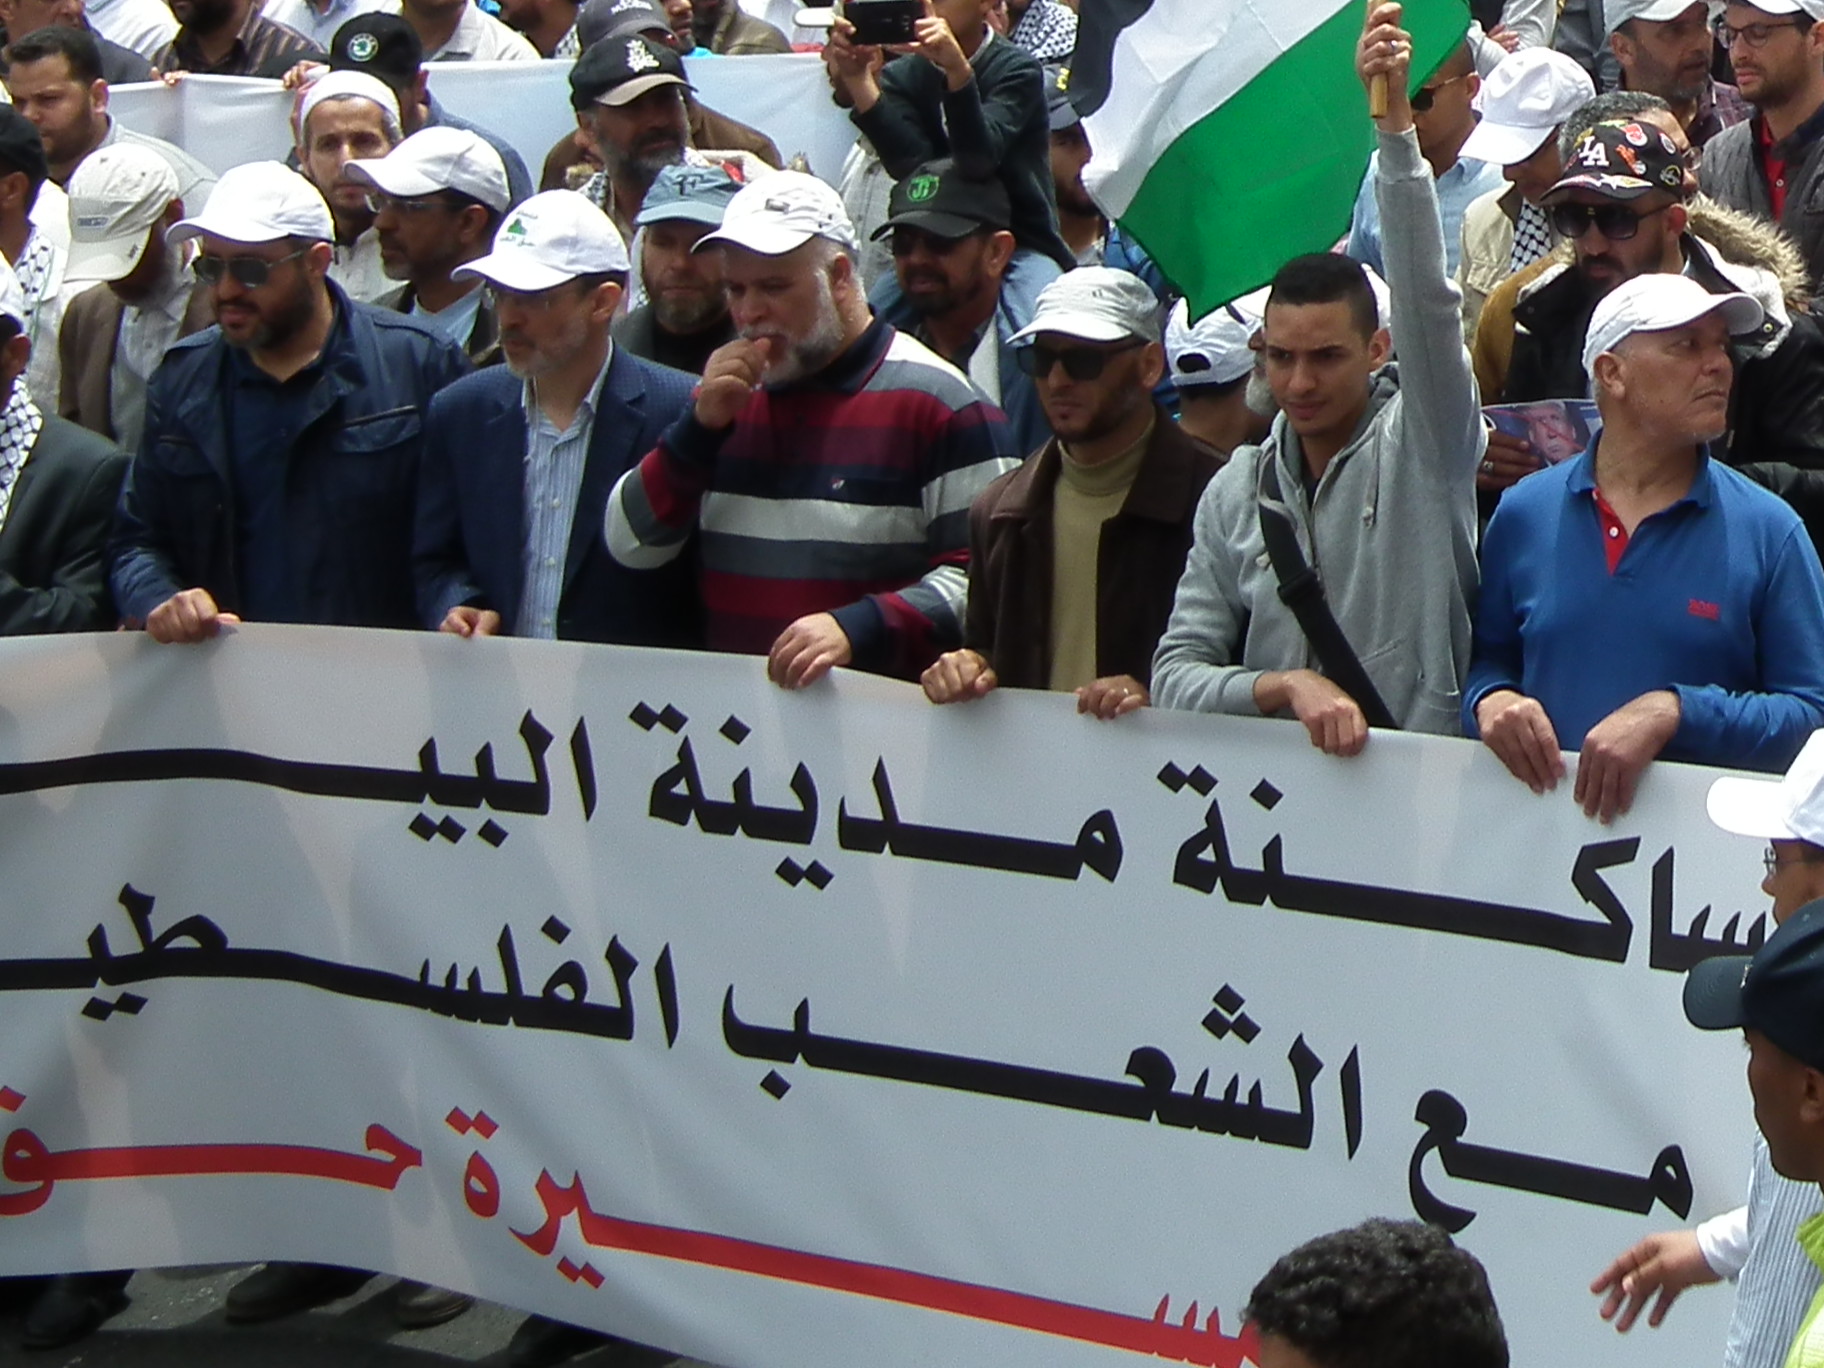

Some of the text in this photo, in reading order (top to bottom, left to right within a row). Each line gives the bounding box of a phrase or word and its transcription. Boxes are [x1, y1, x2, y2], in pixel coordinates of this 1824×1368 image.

[1579, 135, 1610, 167] LA
[0, 702, 1766, 972] ساكنة مدينة البي
[0, 883, 1694, 1232] مع الشعب الفلسطي
